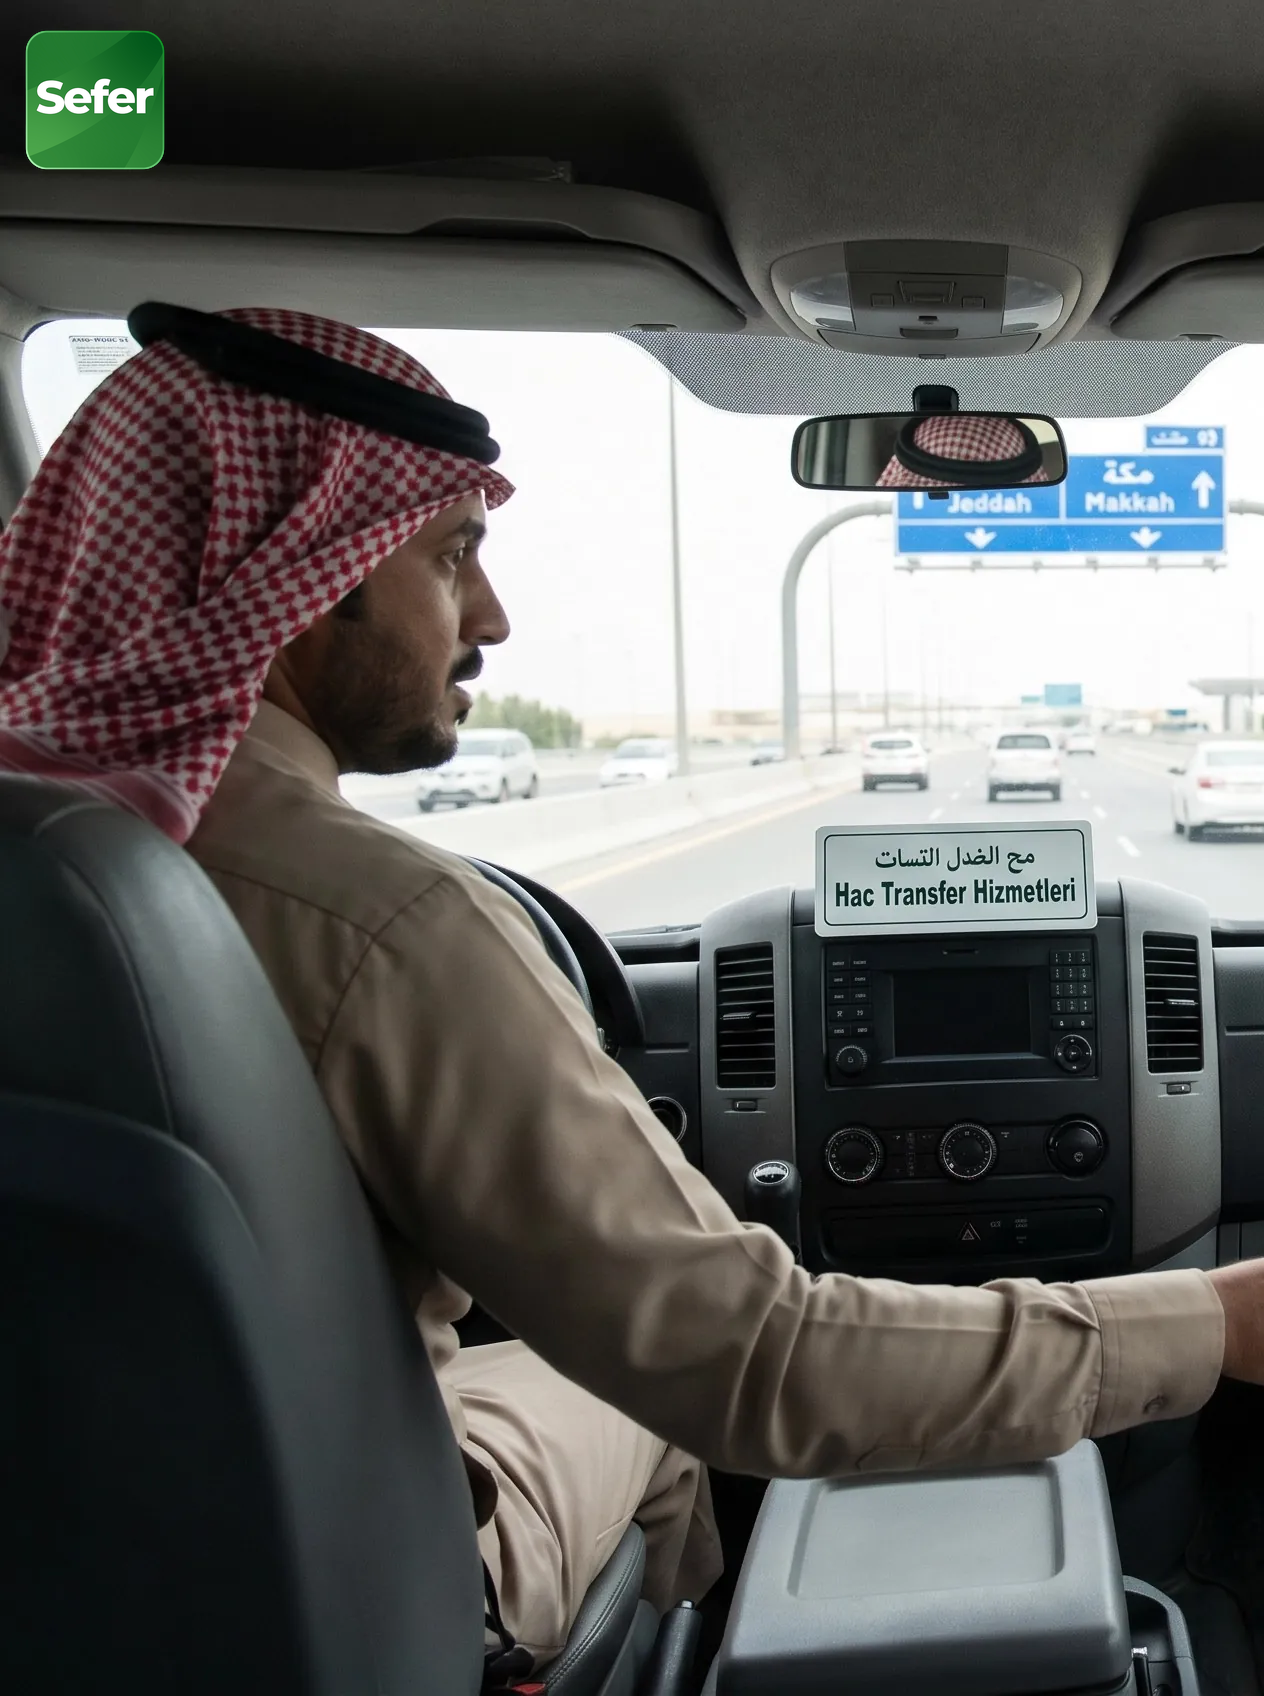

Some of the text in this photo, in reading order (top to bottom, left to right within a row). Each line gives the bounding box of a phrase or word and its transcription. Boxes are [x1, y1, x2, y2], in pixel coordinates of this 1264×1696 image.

[1102, 459, 1155, 485] مكة
[947, 492, 1032, 514] Jeddah
[1084, 491, 1175, 513] Makkah
[835, 877, 1076, 907] Hac Transfer Hizmetleri
